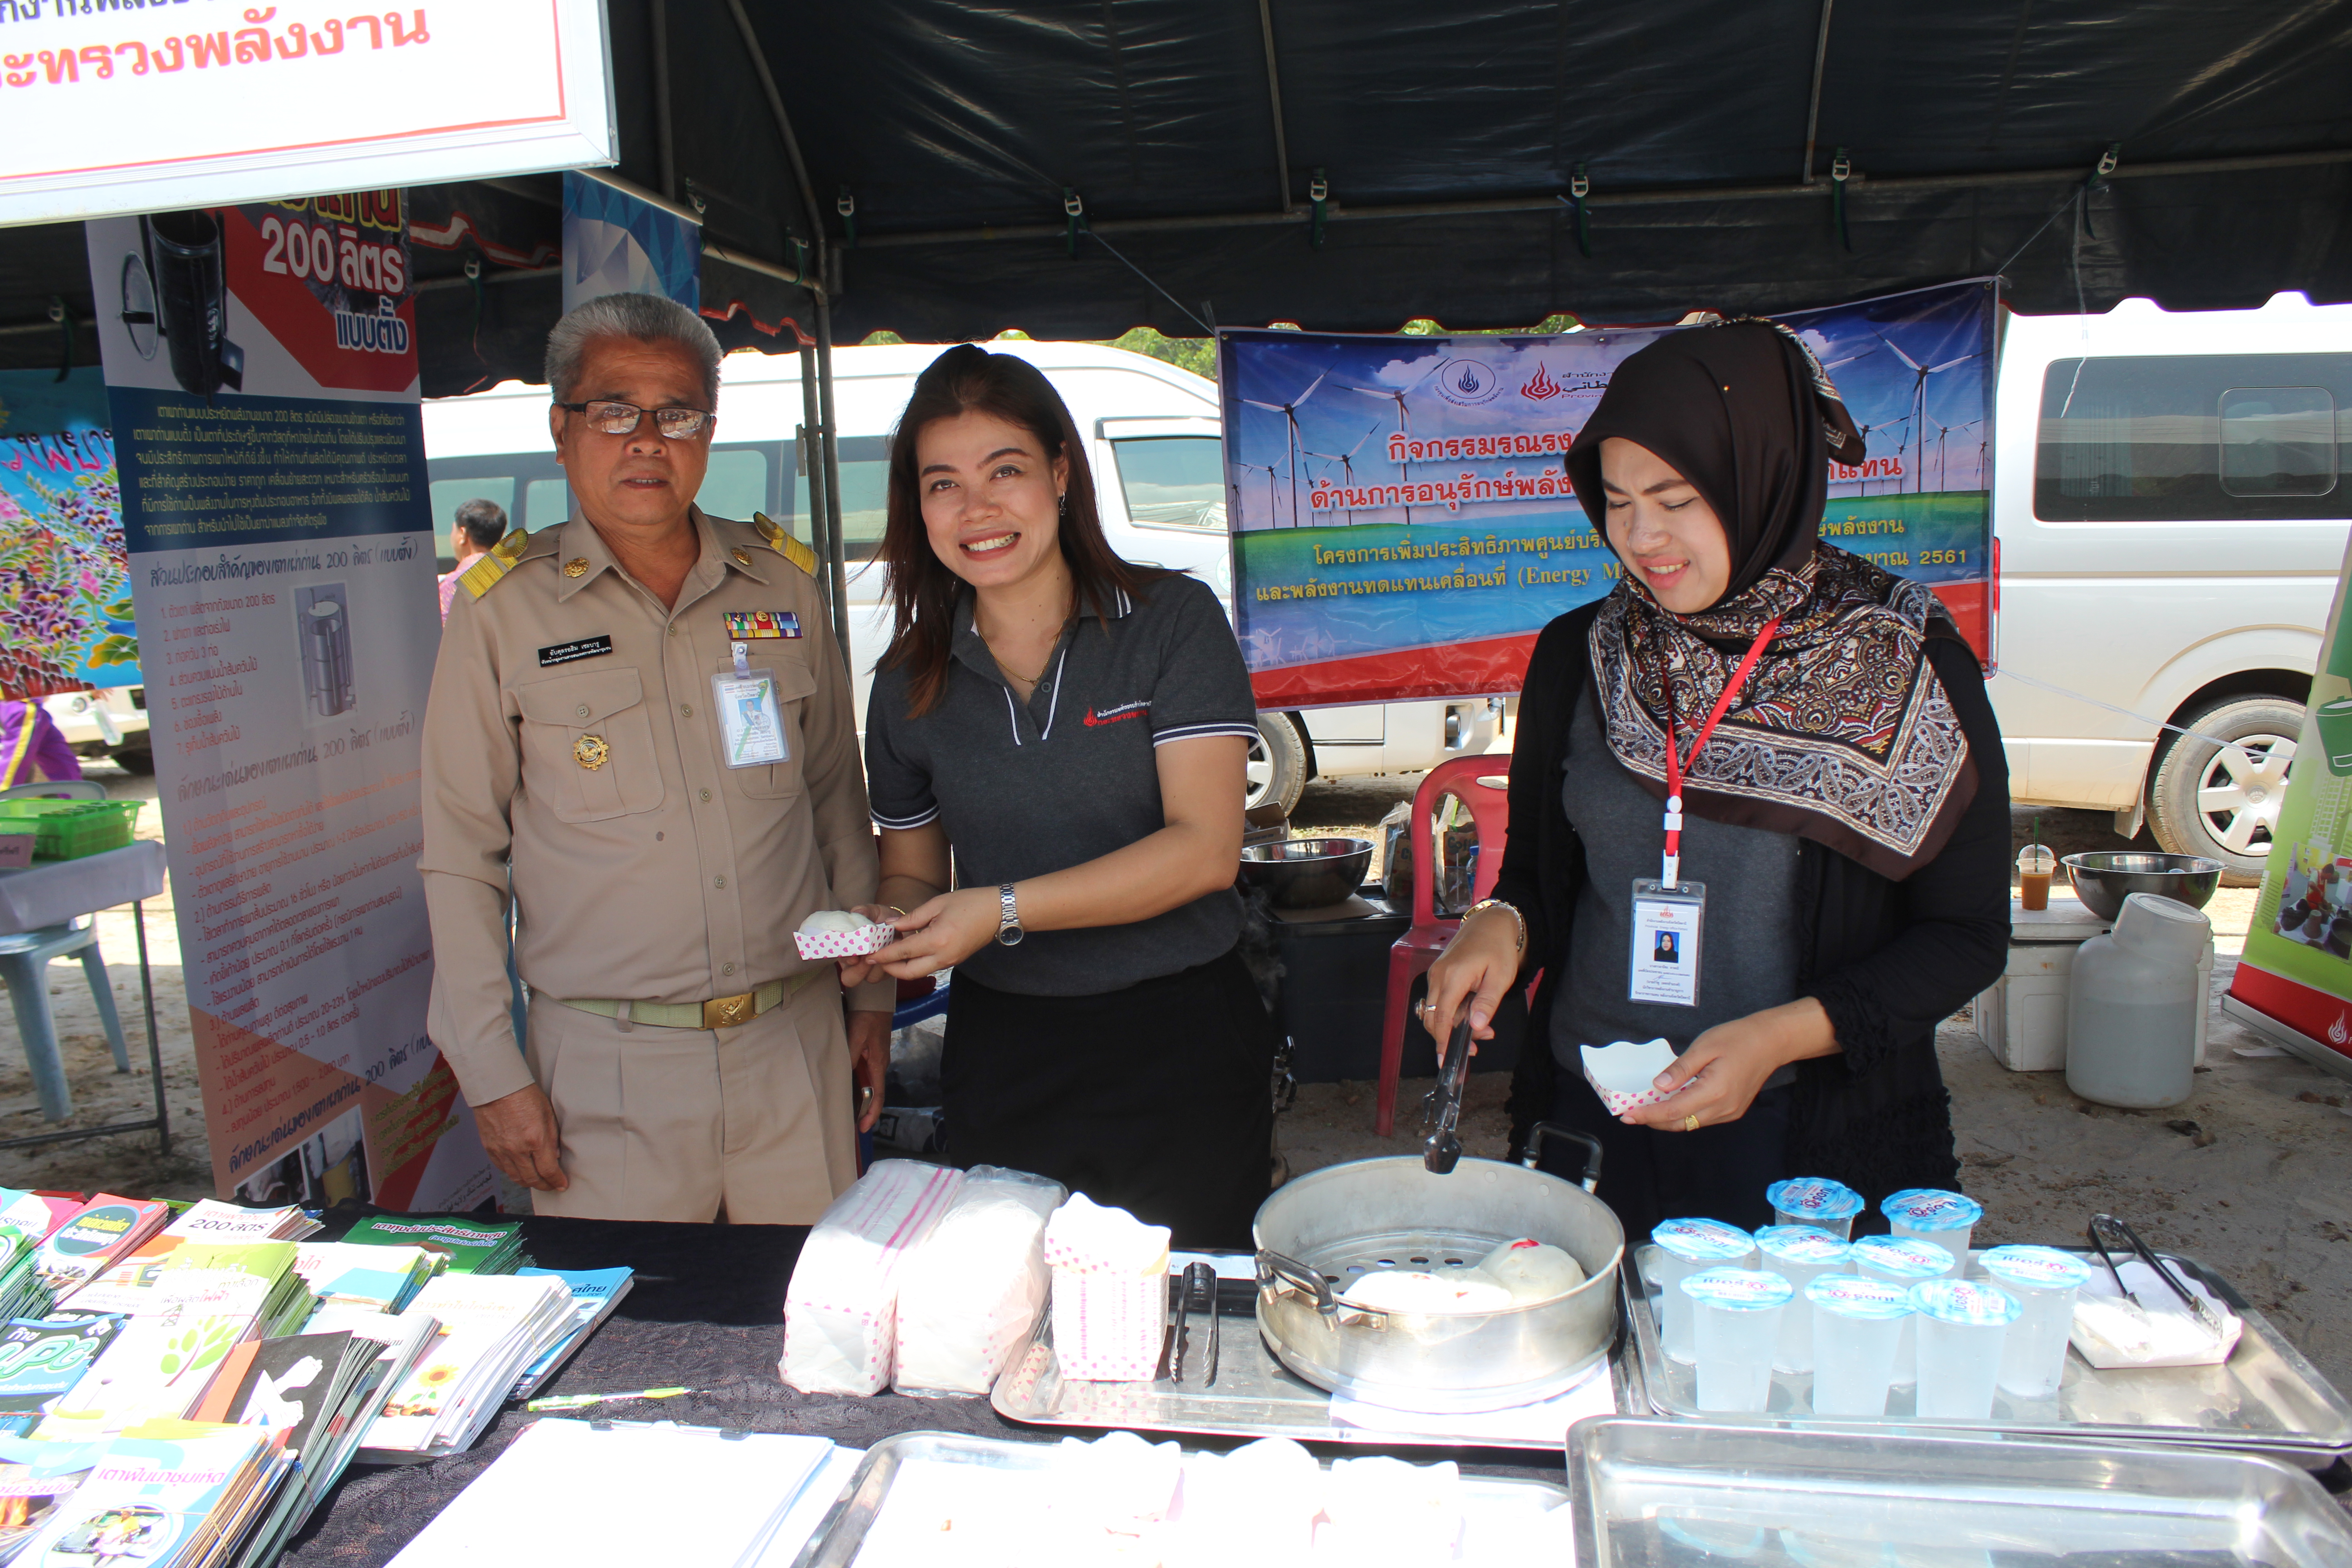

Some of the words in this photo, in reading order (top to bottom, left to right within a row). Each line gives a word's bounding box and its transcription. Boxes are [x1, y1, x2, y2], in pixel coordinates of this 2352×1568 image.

[0, 6, 430, 89] ะทรวงพลังงาน
[261, 216, 335, 282] 200
[339, 227, 405, 294] ลิตร
[336, 296, 408, 354] แบบตั้ง
[274, 410, 288, 422] 200
[289, 410, 303, 423] ลิตร
[1388, 431, 1582, 462] กิจกรรมรณรง
[326, 550, 348, 568] 200
[353, 544, 372, 566] ลิตร
[1314, 528, 1606, 565] โครงการเพิ่มประสิทธิภาพศูนย์บริ
[1256, 560, 1507, 602] และพลังงานทดแทนเคลื่อนที่
[1517, 565, 1591, 590] (Energy
[1919, 549, 1967, 564] 2561
[245, 595, 260, 608] 200
[261, 593, 276, 605] ลิตร
[323, 738, 345, 759] 200
[349, 727, 371, 751] ลิตร
[251, 944, 279, 965] ประมาณ
[295, 1008, 320, 1030] ประมาณ
[365, 1060, 385, 1087] 200
[388, 1044, 408, 1070] ลิตร
[188, 1219, 231, 1230] 200
